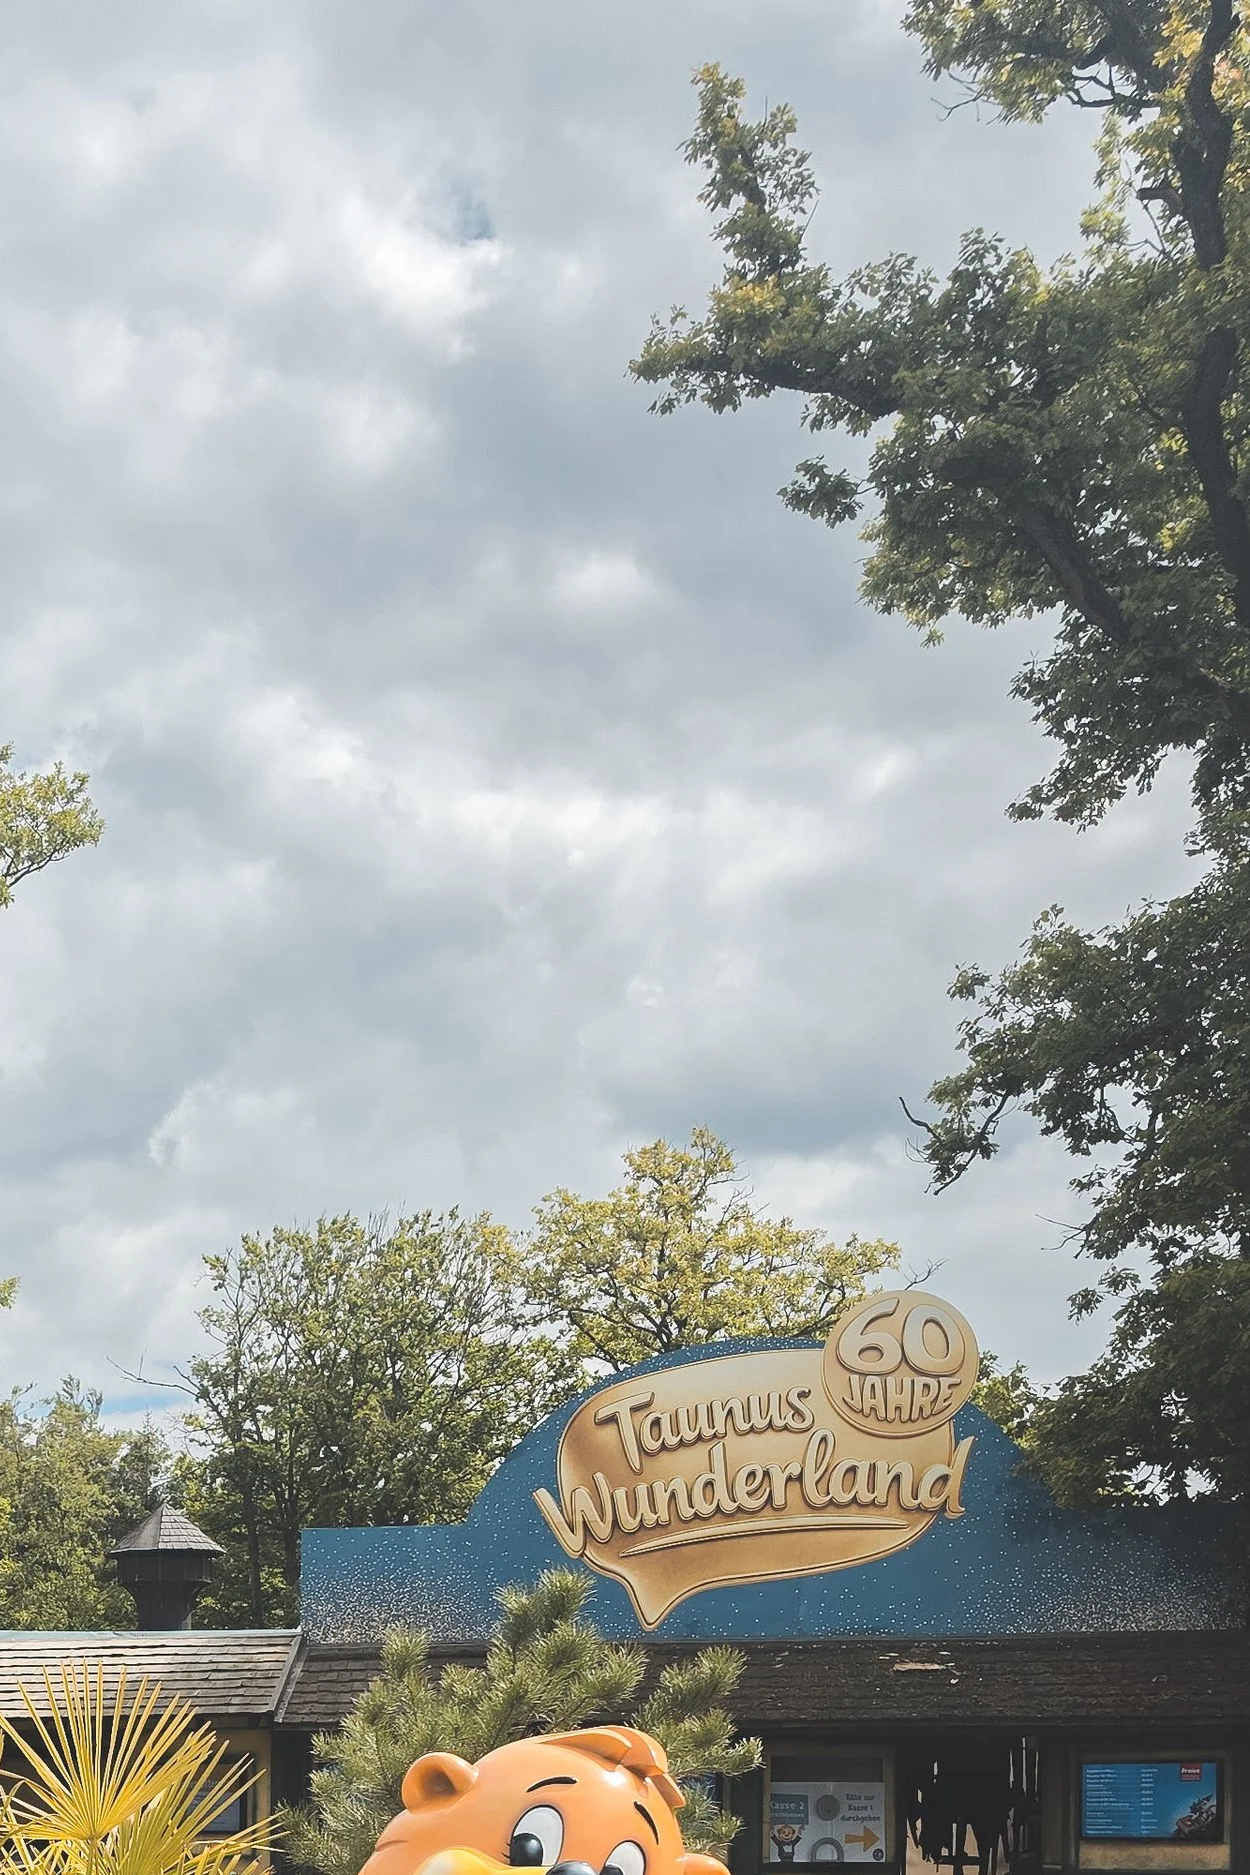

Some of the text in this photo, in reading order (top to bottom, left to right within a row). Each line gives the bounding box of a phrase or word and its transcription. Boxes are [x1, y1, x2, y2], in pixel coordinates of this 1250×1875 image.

[835, 1297, 967, 1376] 60
[594, 1384, 816, 1474] Taunus
[841, 1374, 963, 1423] JAHRE
[531, 1427, 976, 1559] Wunderland
